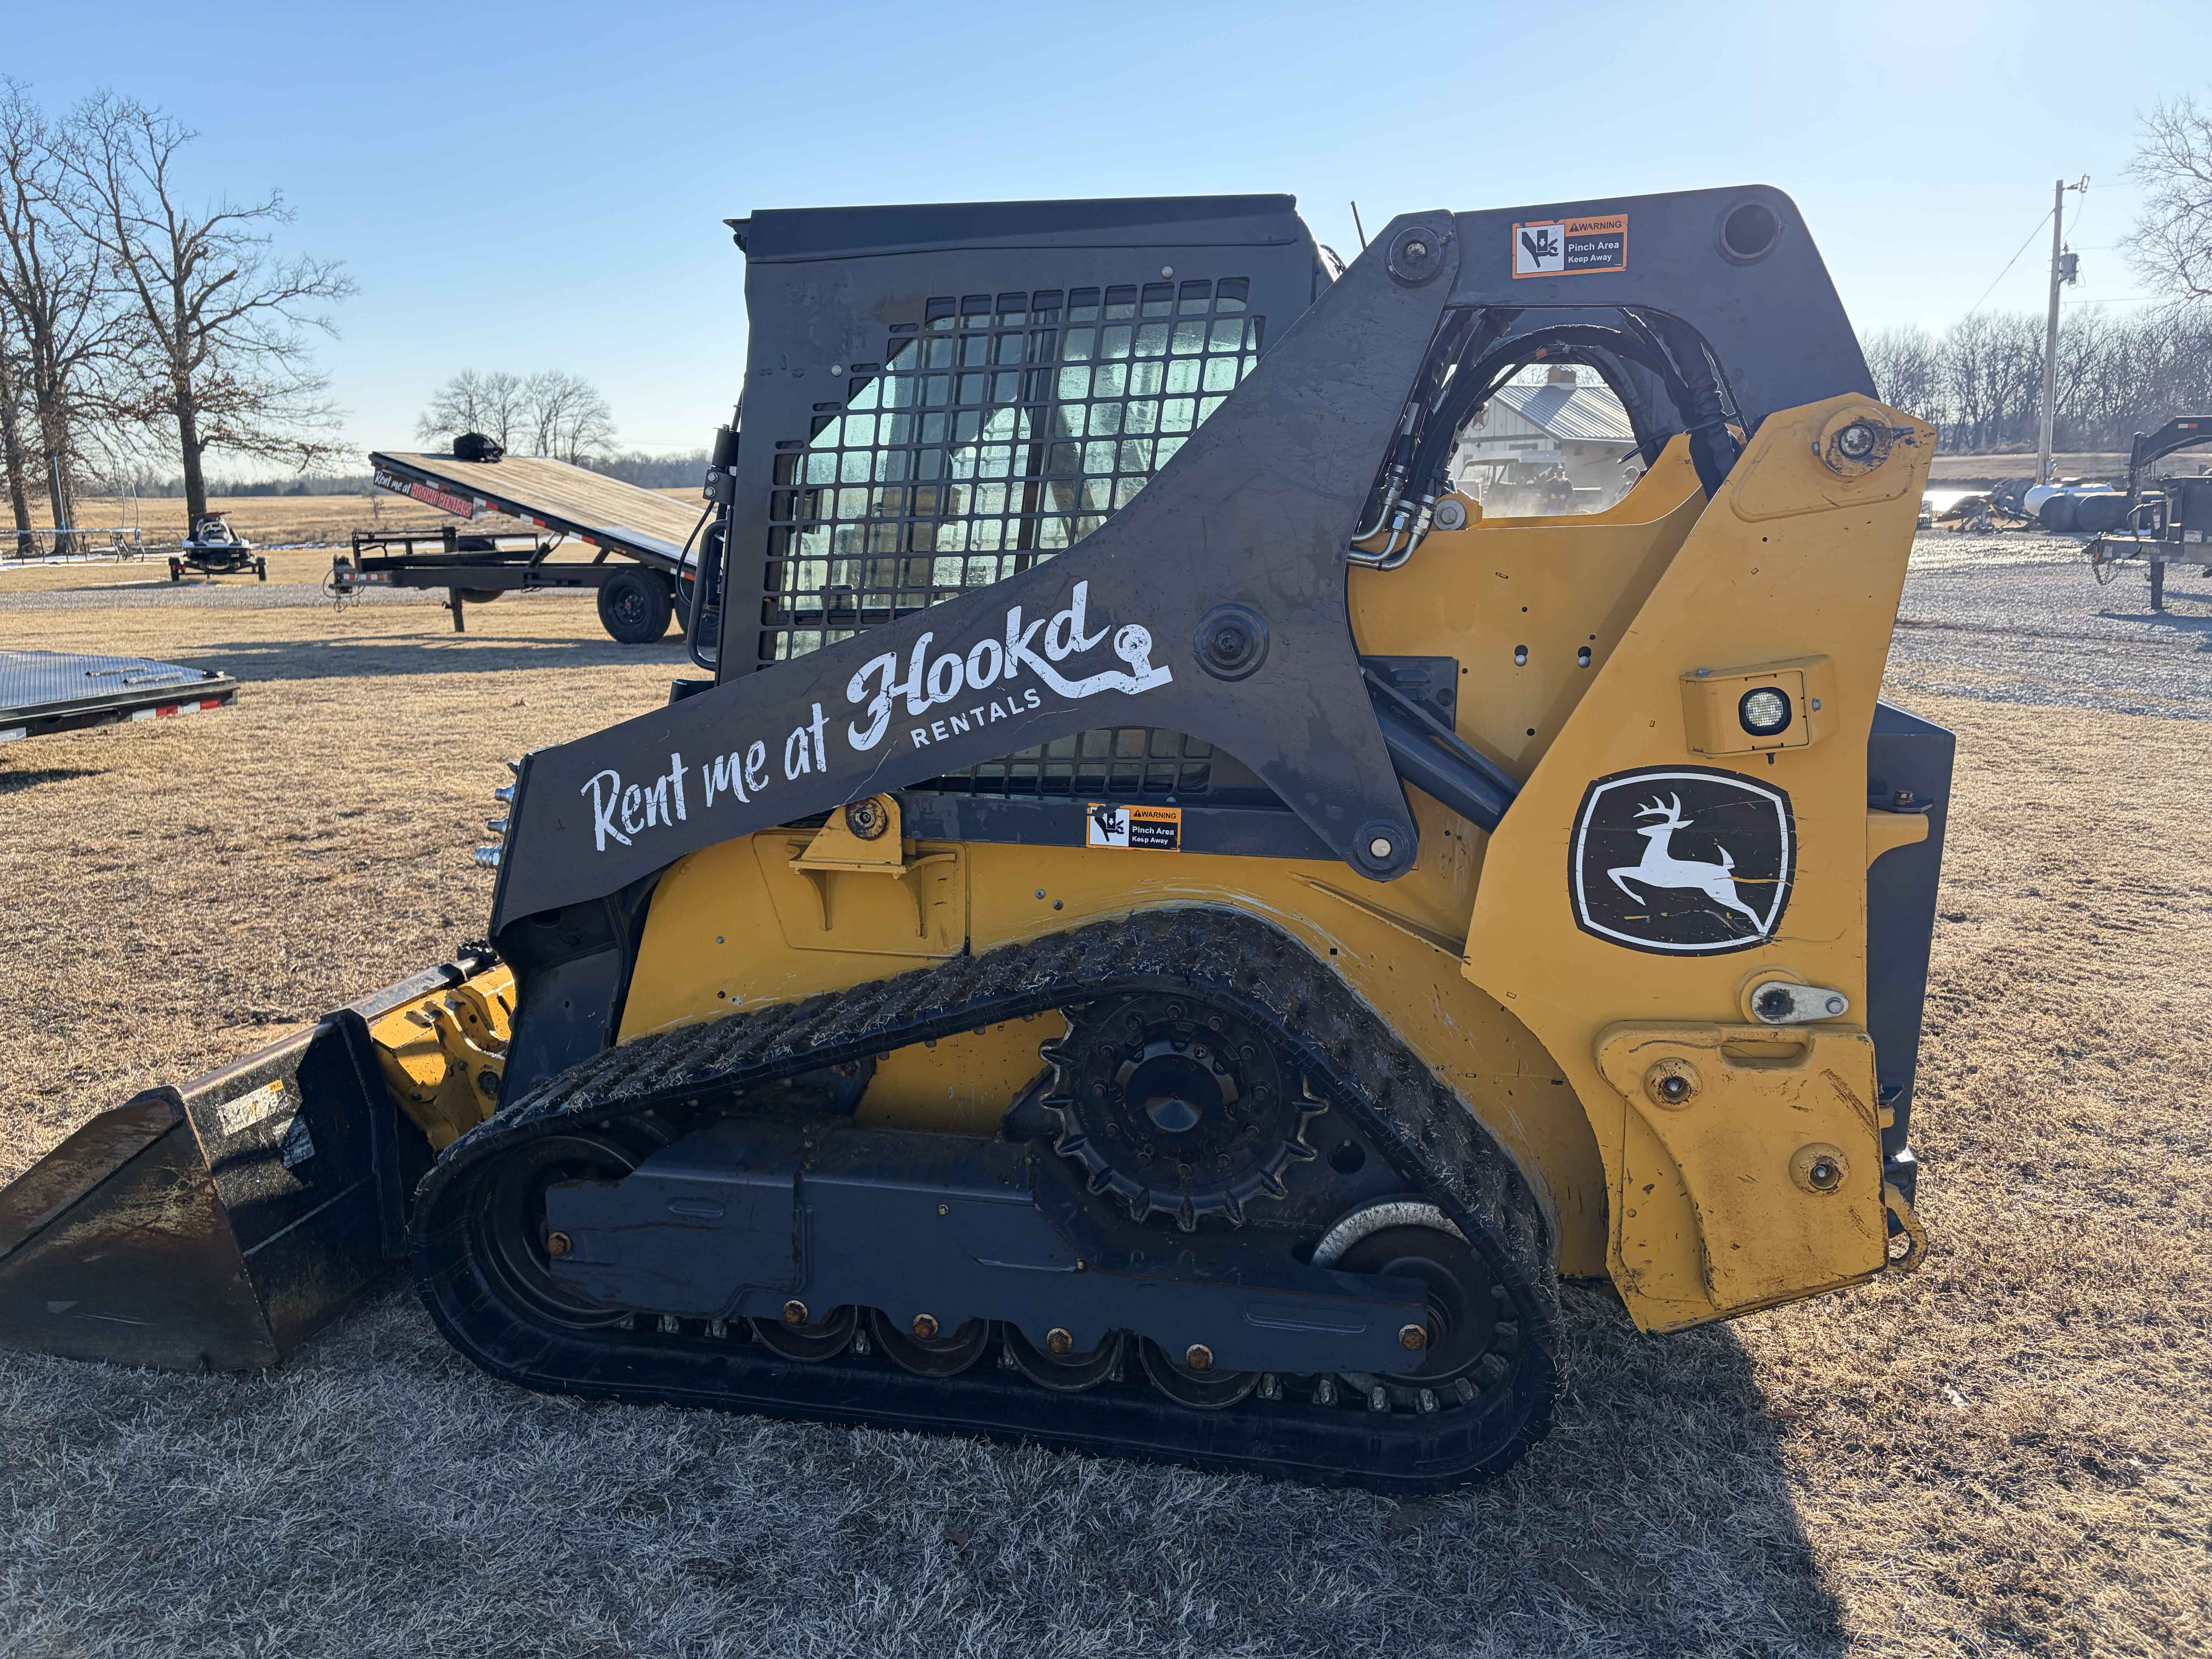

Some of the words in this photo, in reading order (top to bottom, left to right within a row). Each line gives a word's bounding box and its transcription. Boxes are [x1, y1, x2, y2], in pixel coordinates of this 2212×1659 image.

[1579, 220, 1622, 231] WARNING
[1568, 243, 1595, 252] Pinch
[1597, 242, 1620, 250] Area
[374, 470, 391, 485] Rent
[391, 480, 402, 491] me
[402, 482, 412, 494] at
[410, 483, 440, 505] HOOKD
[437, 492, 472, 517] RENTALS
[581, 753, 689, 851] Rent
[704, 740, 769, 807] me
[785, 703, 830, 780] at
[847, 580, 1115, 751] Hookd
[910, 689, 1041, 748] RENTALS
[1132, 826, 1154, 834] Pinch
[1156, 827, 1174, 835] Area
